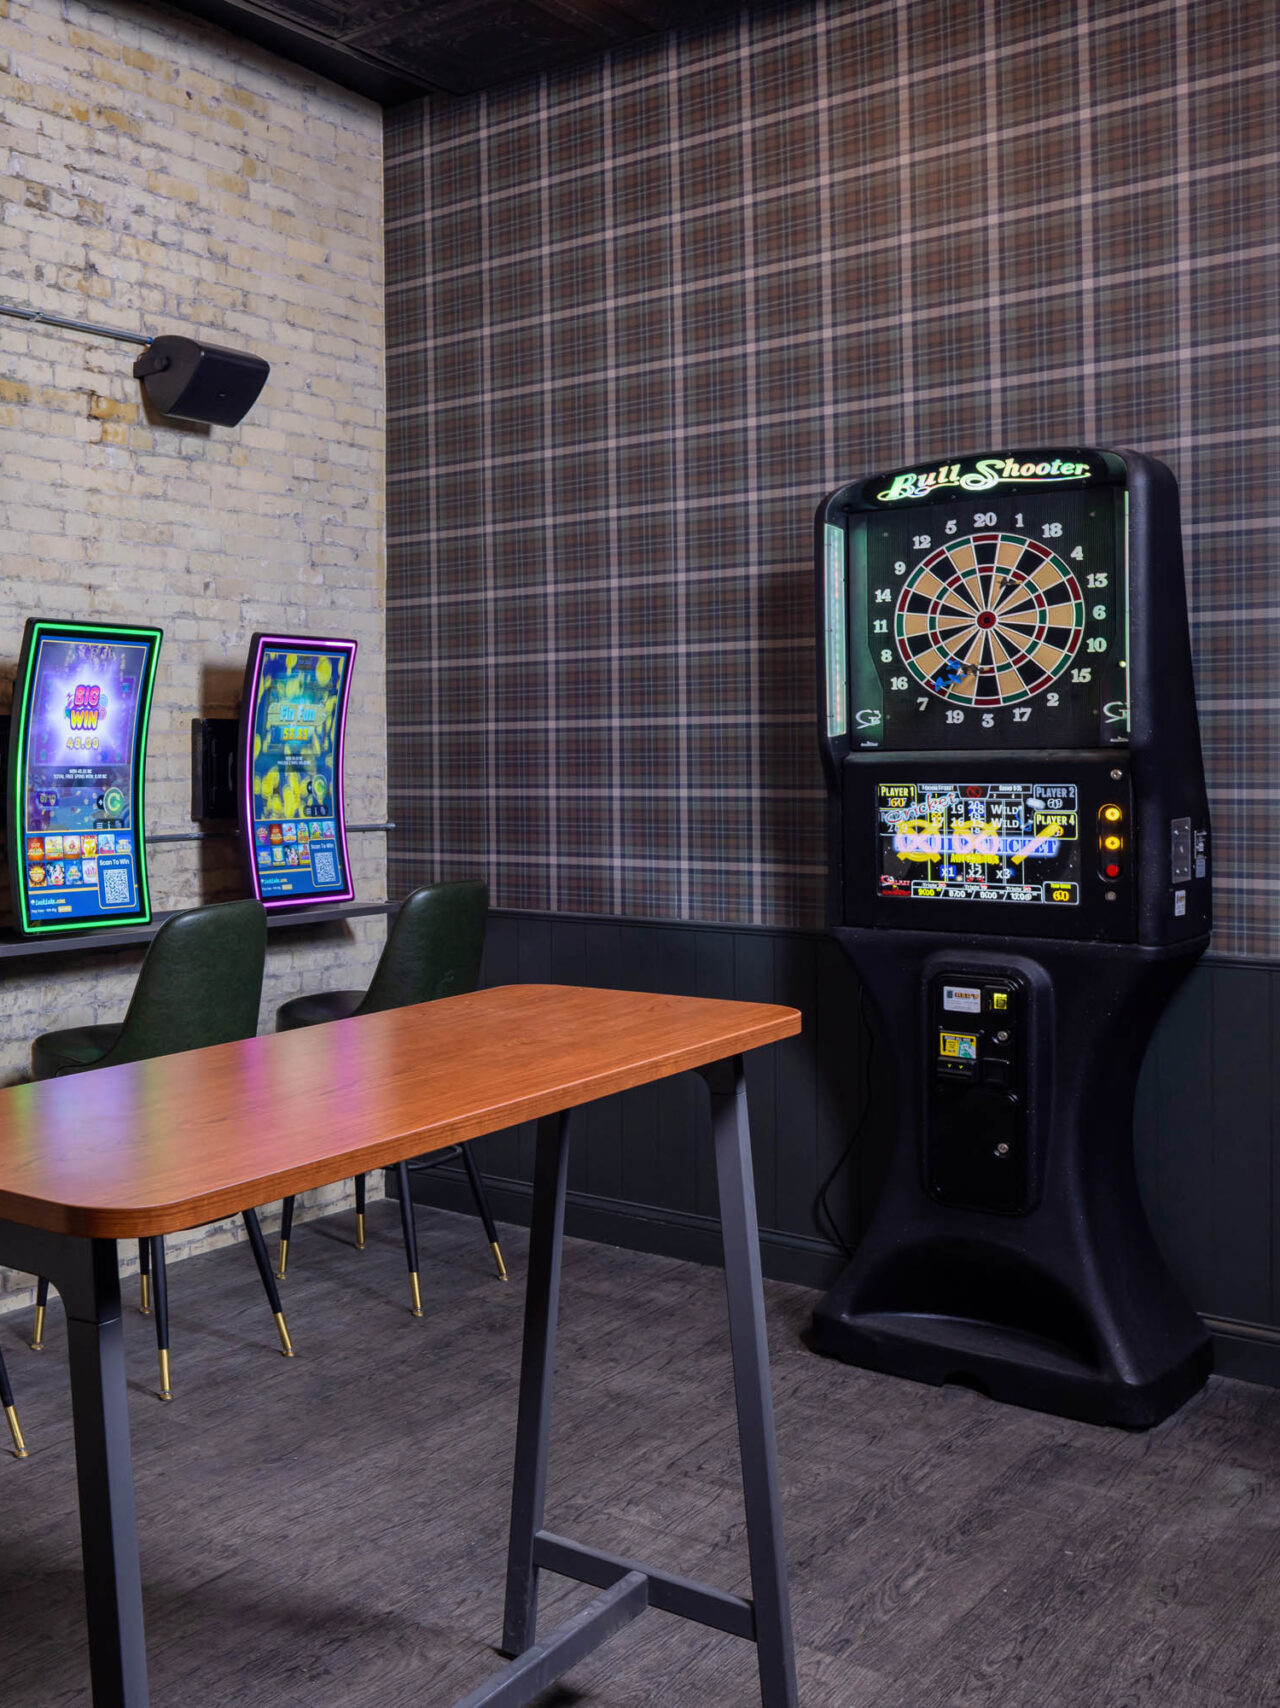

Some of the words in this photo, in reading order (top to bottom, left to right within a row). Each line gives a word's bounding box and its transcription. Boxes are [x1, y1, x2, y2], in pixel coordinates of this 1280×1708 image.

[877, 463, 961, 501] Bull
[958, 458, 1091, 490] Shooter
[945, 520, 957, 534] 5
[974, 513, 997, 527] 20
[1016, 514, 1023, 527] 1
[1042, 524, 1062, 538] 18
[912, 535, 931, 549] 12
[1071, 546, 1083, 560] 4
[894, 562, 906, 575] 9
[1087, 574, 1108, 588] 13
[875, 589, 891, 602] 14
[1093, 605, 1106, 620] 6
[874, 620, 888, 633] 11
[1087, 637, 1107, 652] 10
[881, 650, 892, 663] 8
[1071, 668, 1091, 683] 15
[891, 677, 908, 690] 16
[74, 685, 100, 707] BIG
[1047, 693, 1059, 707] 2
[917, 697, 928, 711] 7
[70, 708, 99, 730] WIN
[297, 707, 316, 722] Fun
[946, 710, 964, 724] 19
[982, 714, 994, 728] 3
[1013, 708, 1032, 722] 17
[881, 786, 908, 797] PLAYER
[910, 787, 914, 797] 1
[1036, 787, 1067, 798] PLAYER
[1069, 787, 1074, 798] 2
[885, 792, 960, 824] Cricket
[951, 804, 964, 814] 19
[1036, 814, 1067, 825] PLAYER
[1069, 815, 1075, 825] 4
